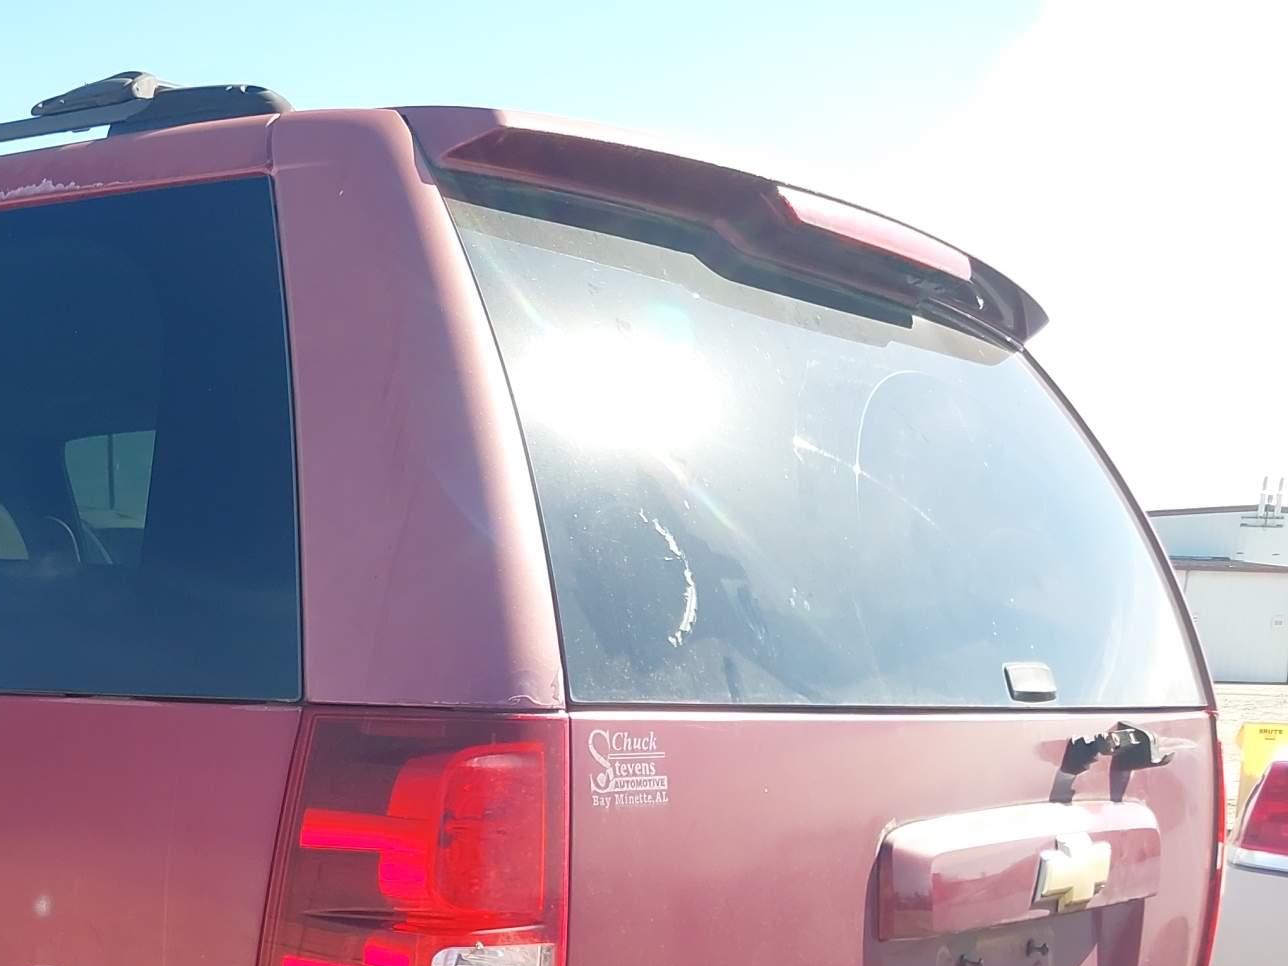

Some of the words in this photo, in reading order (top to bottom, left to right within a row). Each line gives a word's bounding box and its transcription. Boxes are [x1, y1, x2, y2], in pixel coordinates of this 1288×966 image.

[612, 731, 657, 751] Chuck
[613, 778, 666, 789] AUTOMOTIVE
[592, 795, 611, 809] Bay
